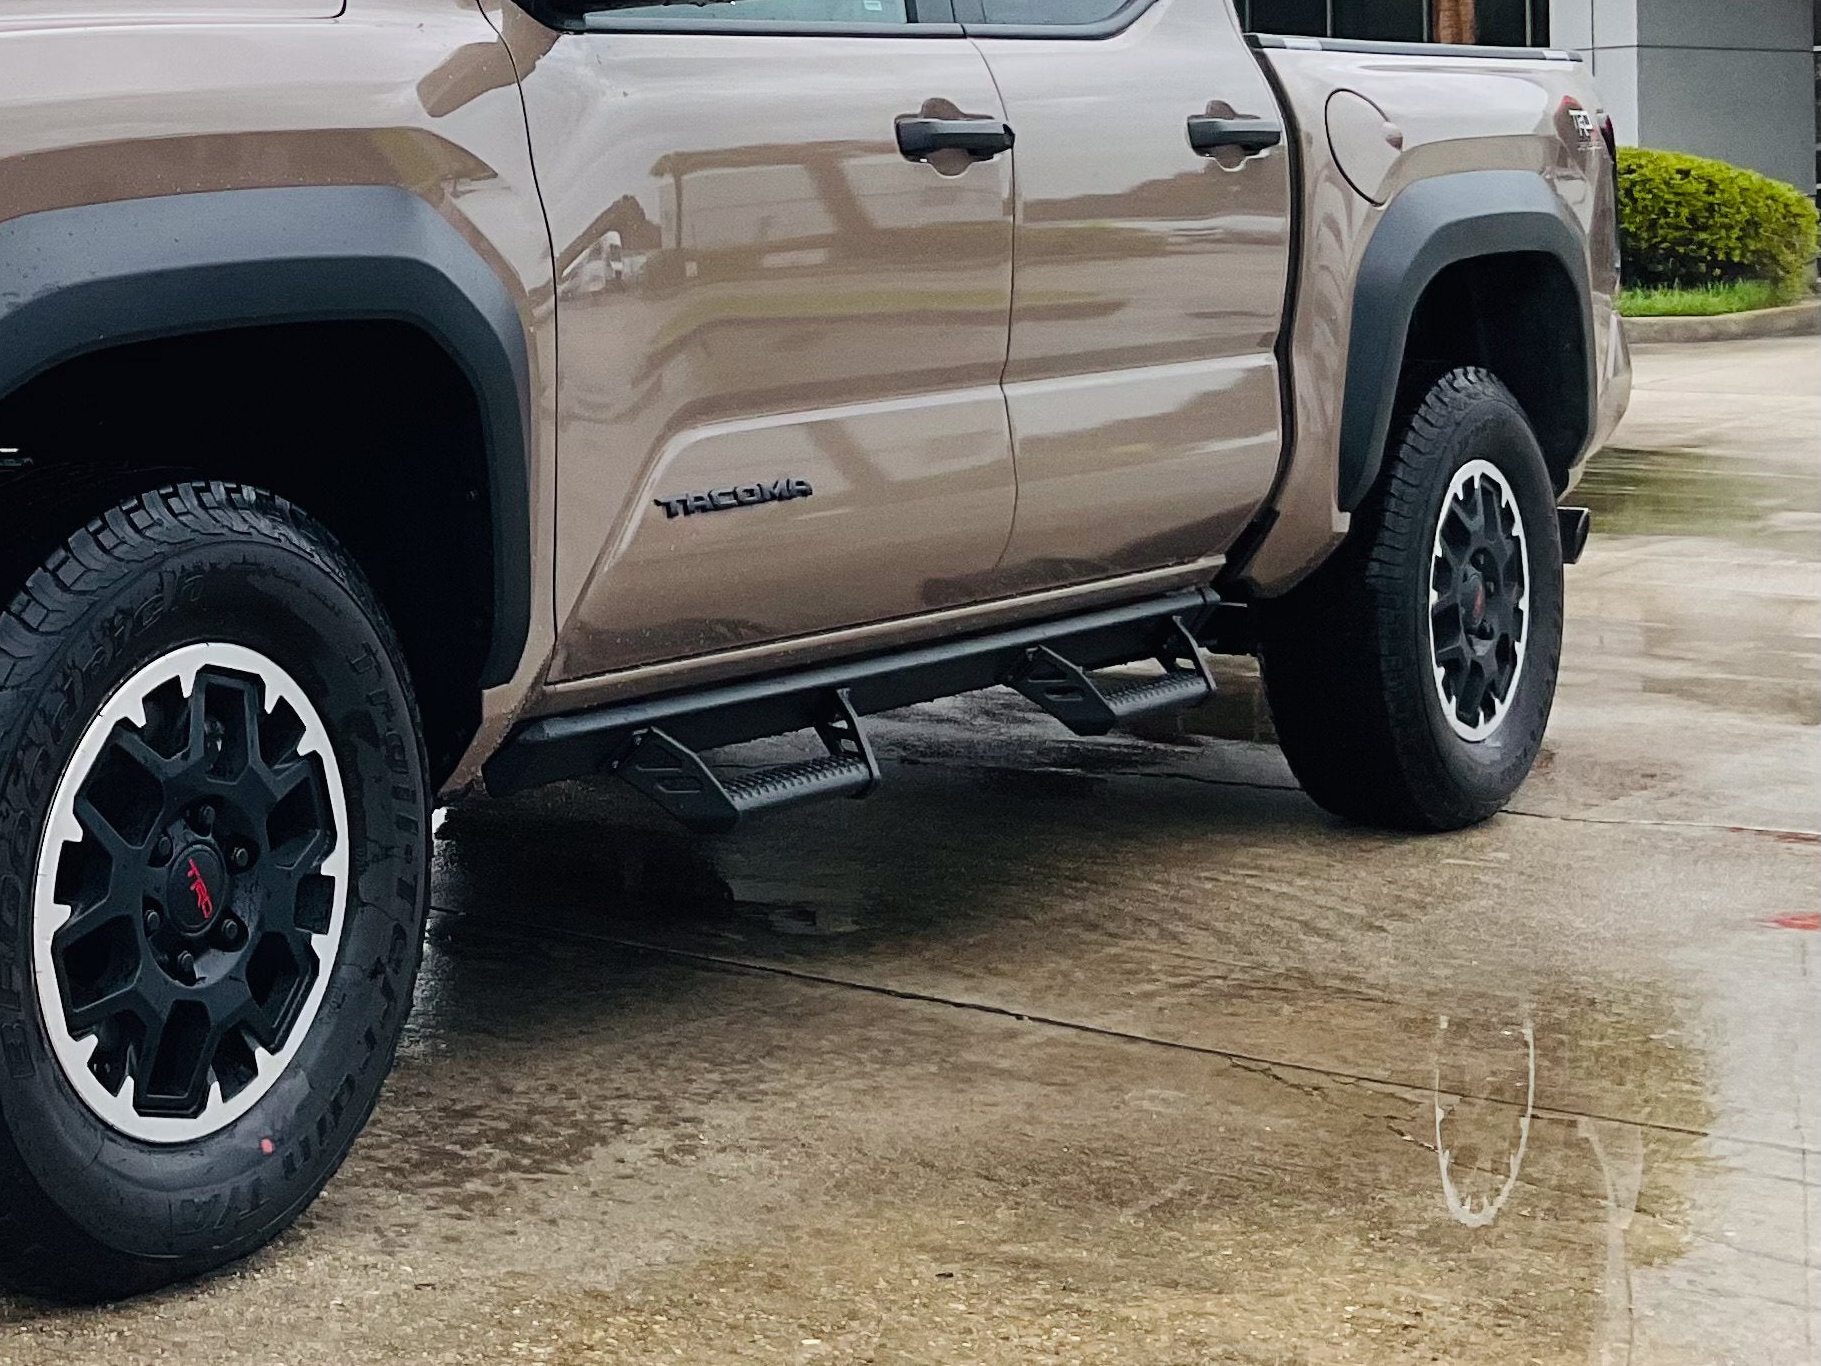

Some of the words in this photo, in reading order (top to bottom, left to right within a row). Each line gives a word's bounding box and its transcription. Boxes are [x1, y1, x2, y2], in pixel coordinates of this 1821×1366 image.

[1569, 109, 1593, 136] TRD
[653, 479, 813, 519] TACOMA
[187, 856, 214, 919] TRD
